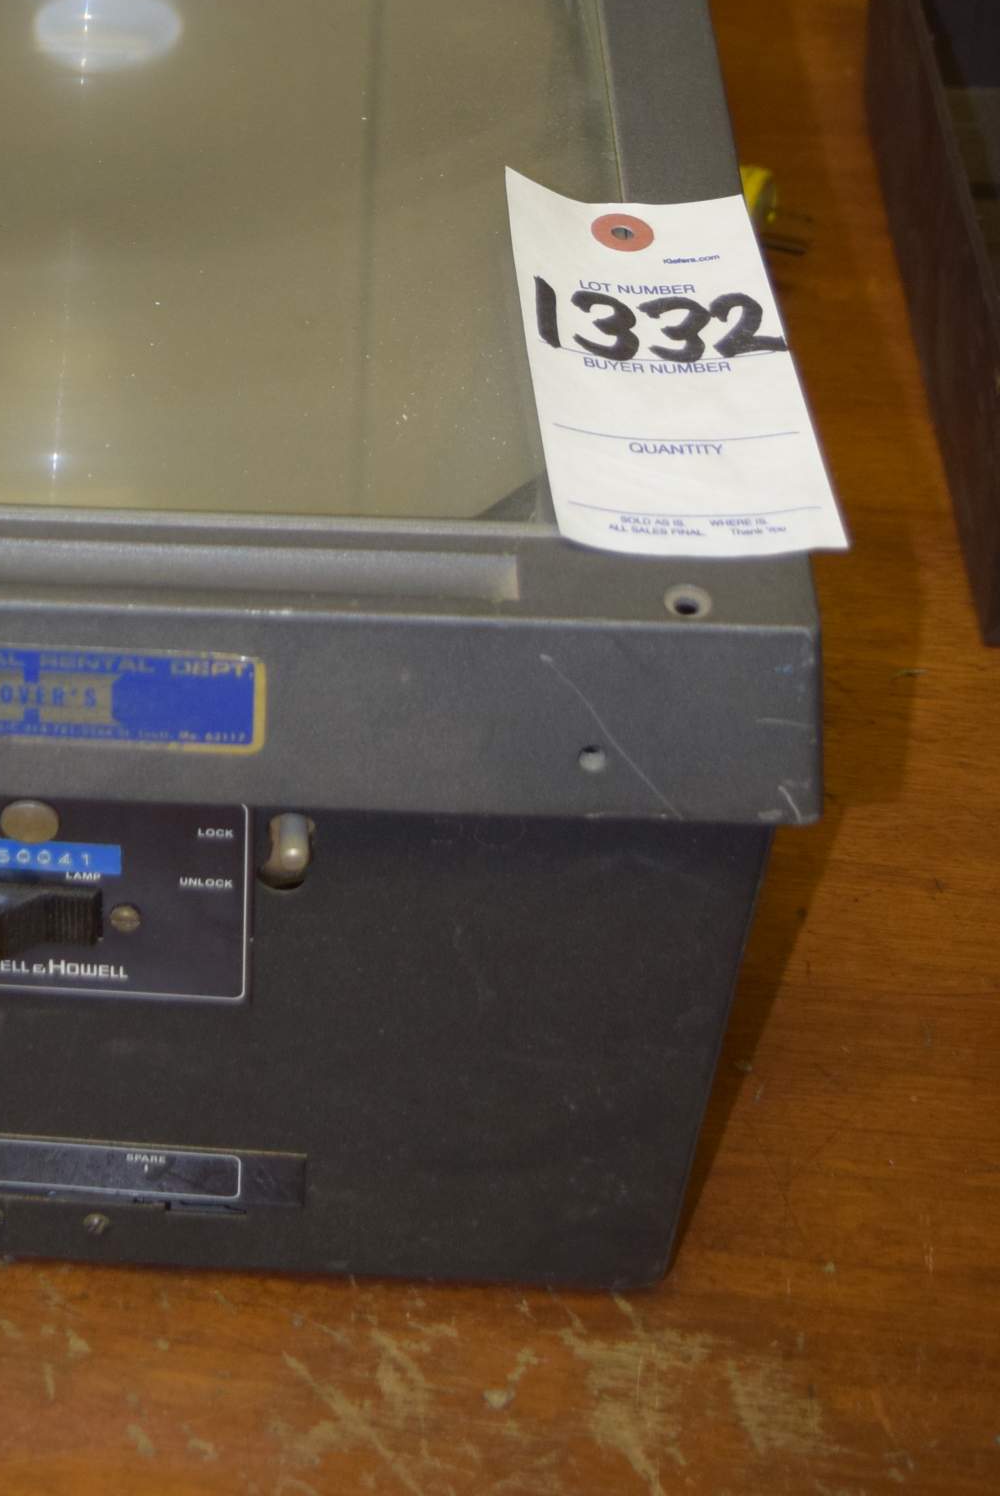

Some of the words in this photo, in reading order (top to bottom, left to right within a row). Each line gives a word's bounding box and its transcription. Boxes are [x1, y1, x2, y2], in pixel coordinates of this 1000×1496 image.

[579, 279, 612, 293] LOT
[617, 282, 696, 295] NUMBER
[533, 275, 788, 363] 1332
[583, 356, 645, 374] BUYER
[650, 361, 732, 375] NUMBER
[629, 441, 724, 456] QUANTITY
[620, 515, 651, 525] SOLD
[655, 517, 670, 526] AS
[709, 518, 751, 526] WHERE
[608, 523, 626, 532] ALL
[631, 525, 667, 535] SALES
[731, 527, 763, 535] Thank
[39, 653, 156, 674] RENTAL
[197, 827, 234, 838] LOCK
[65, 871, 101, 881] LAMP
[179, 877, 233, 889] UNLOCK
[126, 1153, 166, 1164] SPARE
